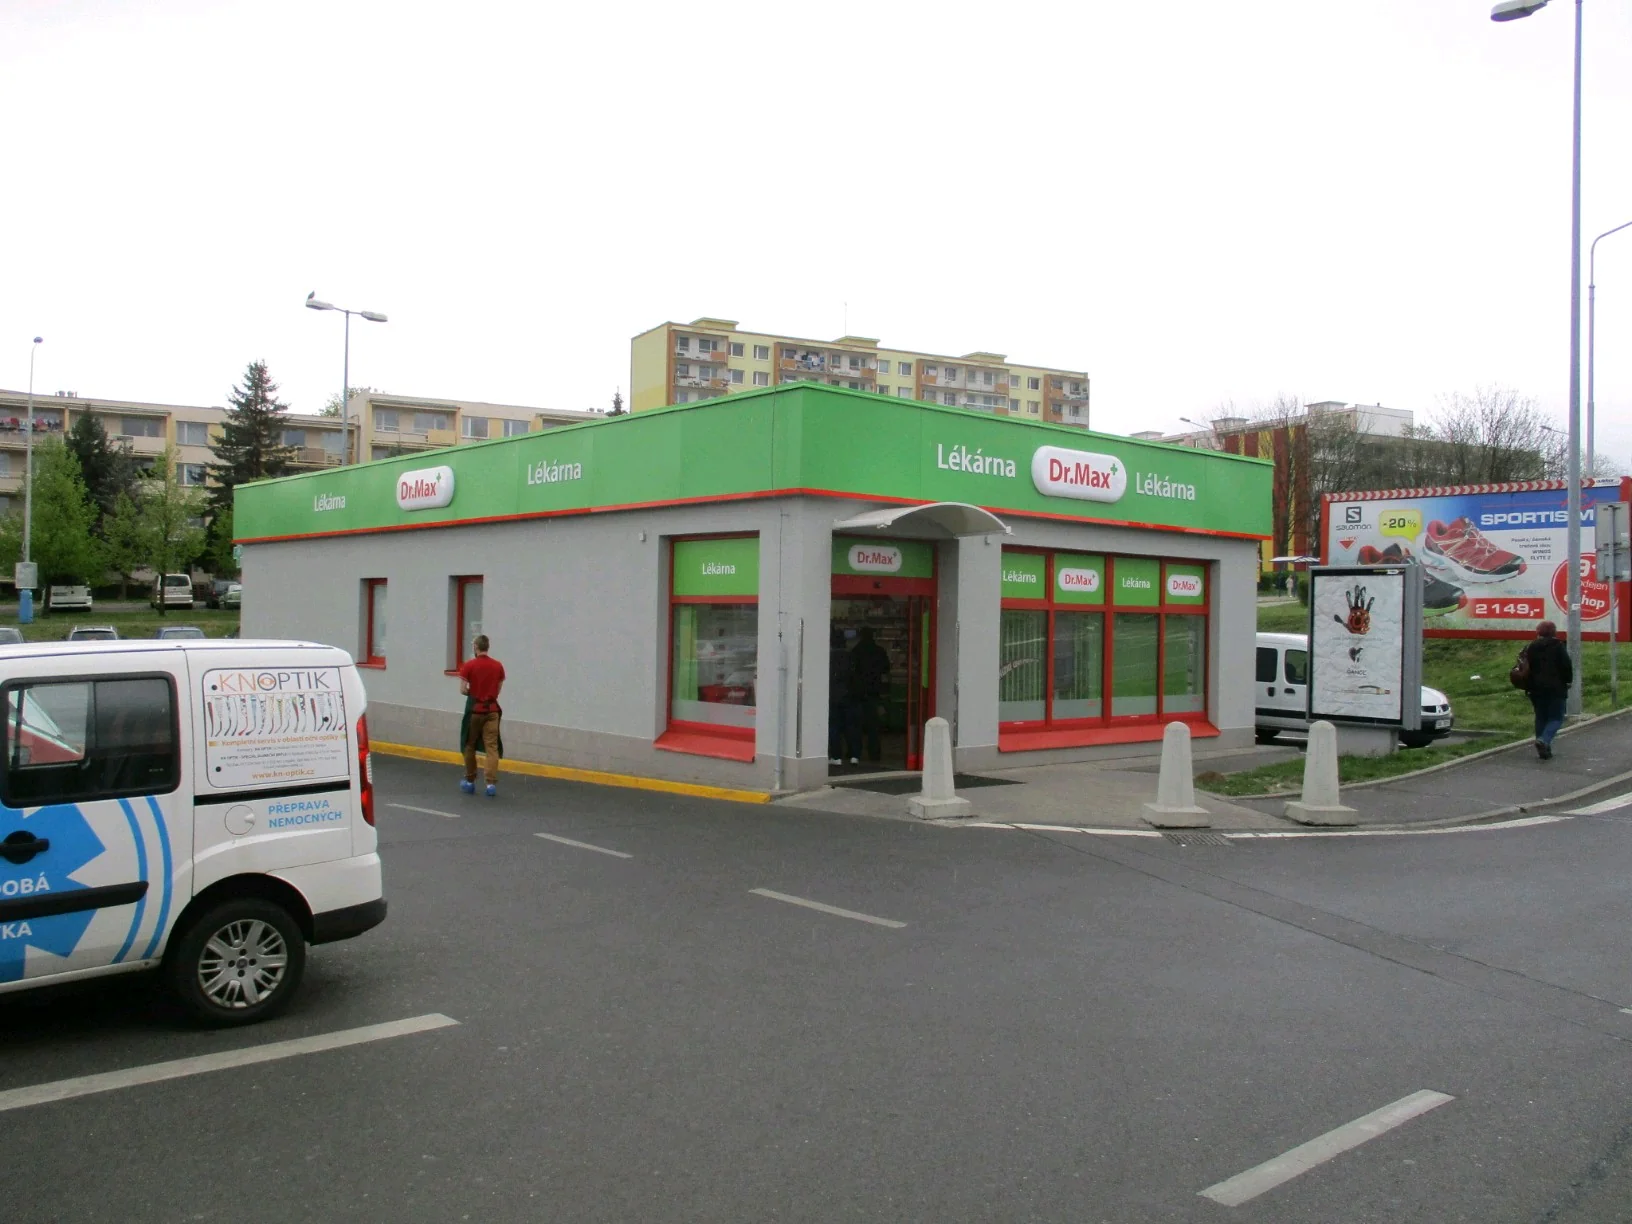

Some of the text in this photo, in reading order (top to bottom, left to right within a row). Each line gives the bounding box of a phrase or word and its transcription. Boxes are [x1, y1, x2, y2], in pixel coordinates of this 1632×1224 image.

[937, 444, 1016, 478] Lékárna
[1135, 471, 1196, 501] Lékárna
[313, 492, 346, 512] Lékárna
[527, 459, 583, 486] Lékárna
[702, 562, 736, 576] Lékárna
[1002, 570, 1037, 584] Lékárna
[1122, 576, 1151, 590] Lékárna
[252, 768, 315, 780] www.kn-optik.cz
[268, 799, 330, 815] PŘEPRAVA
[268, 811, 342, 829] NEMOCNÝCH
[0, 871, 50, 895] OBÁ
[0, 922, 32, 939] KA
